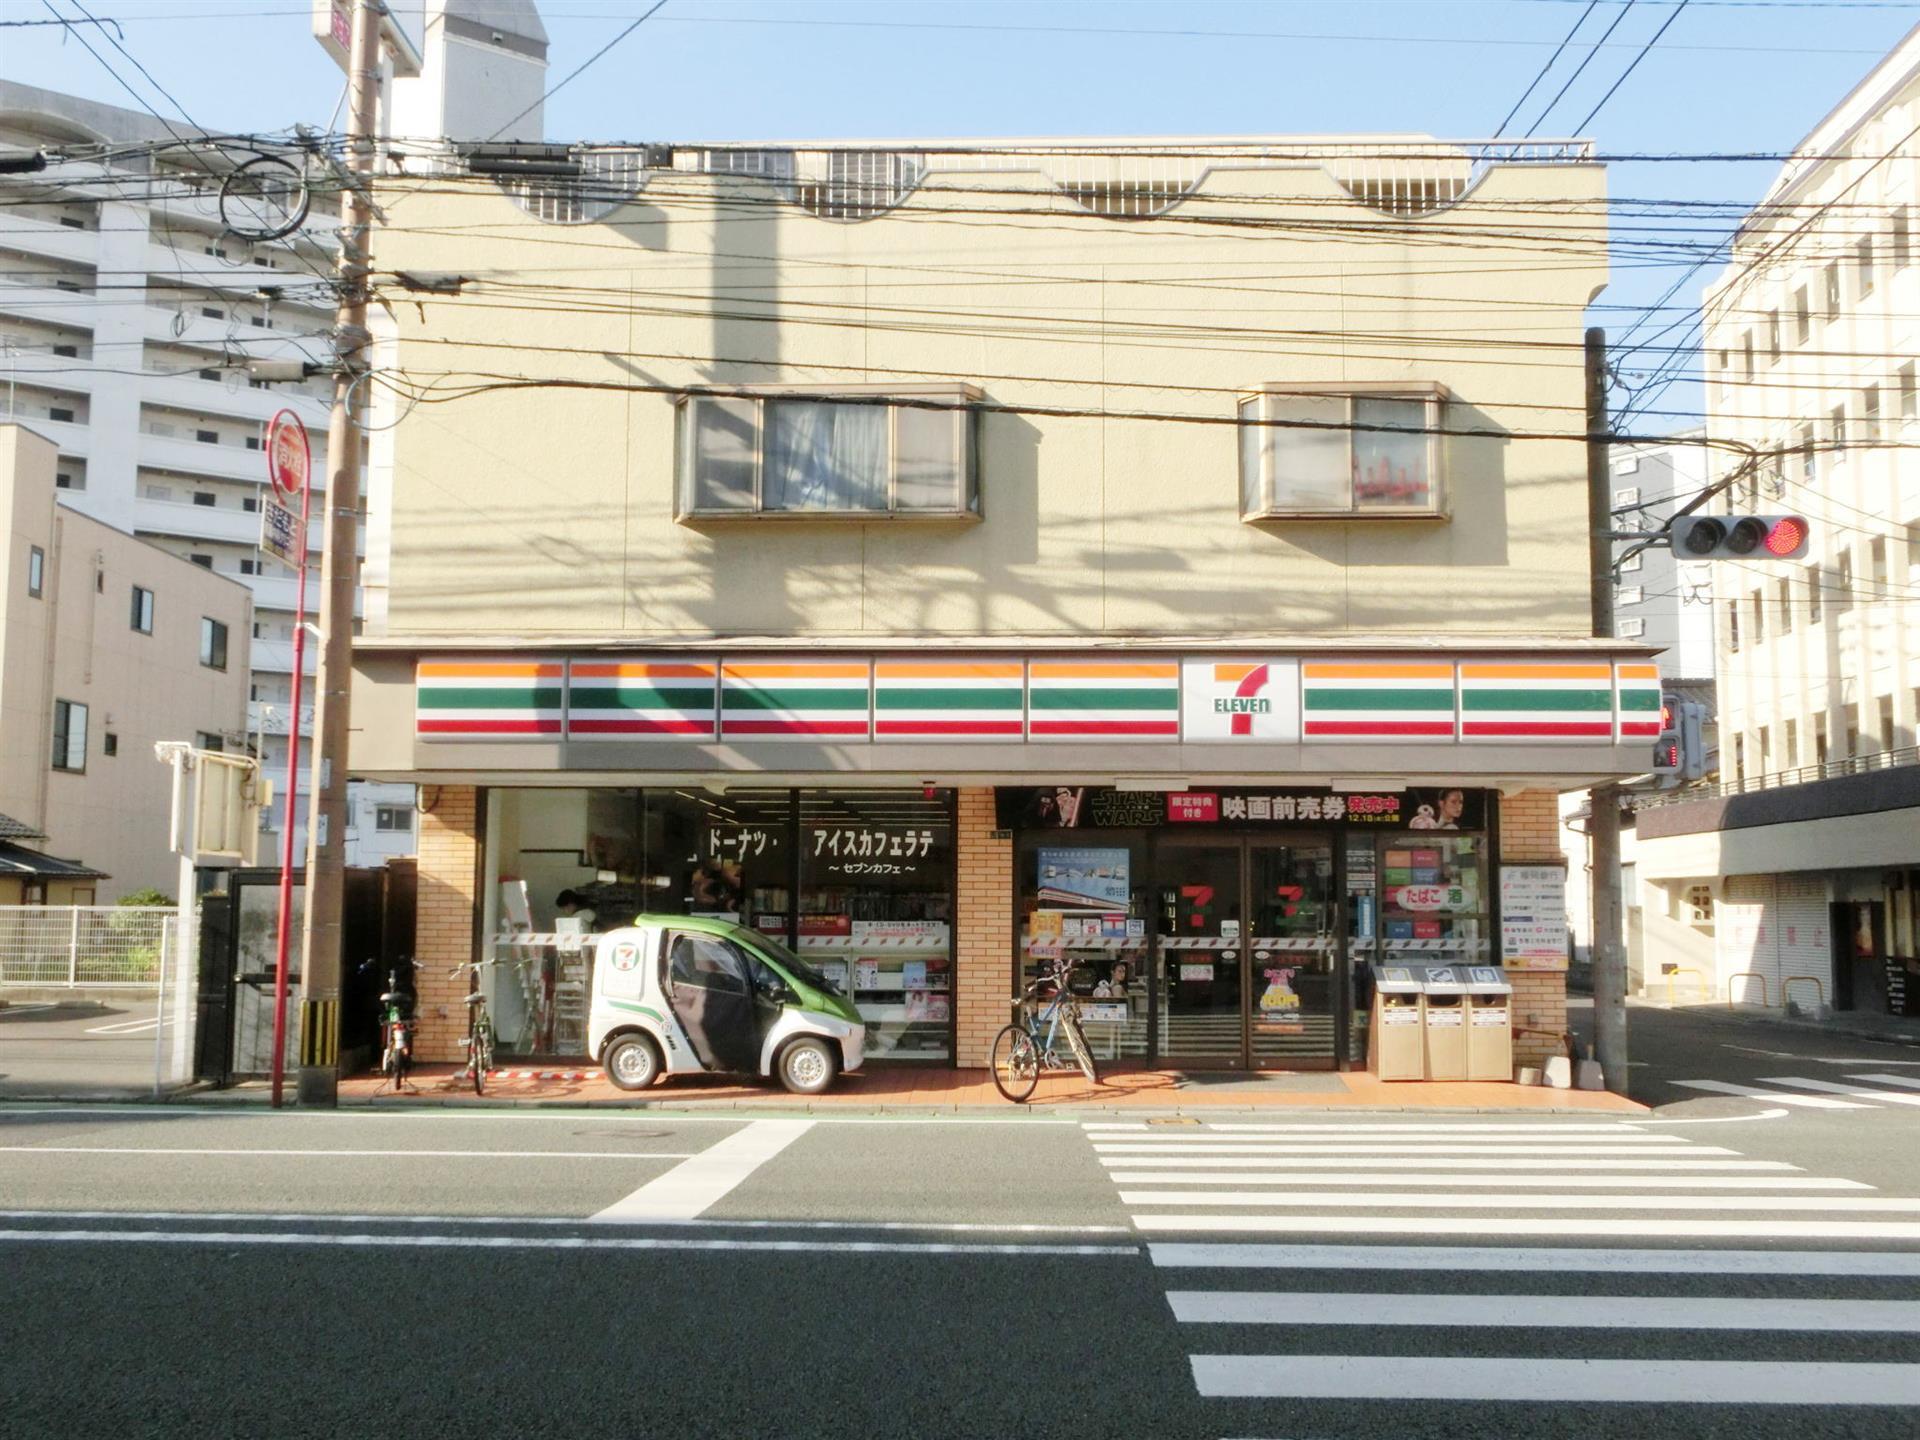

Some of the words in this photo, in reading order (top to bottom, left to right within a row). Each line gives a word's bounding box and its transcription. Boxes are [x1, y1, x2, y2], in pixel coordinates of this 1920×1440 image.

[1214, 663, 1269, 736] 7
[1092, 789, 1163, 805] STAR
[1348, 795, 1401, 814] 発売中
[1183, 808, 1202, 819] 付き
[1221, 795, 1346, 820] 映画前売券
[1092, 809, 1164, 826] WARS
[813, 828, 935, 858] アイスカフェラテ
[1406, 888, 1441, 905] たばこ
[1447, 888, 1463, 904] 酒
